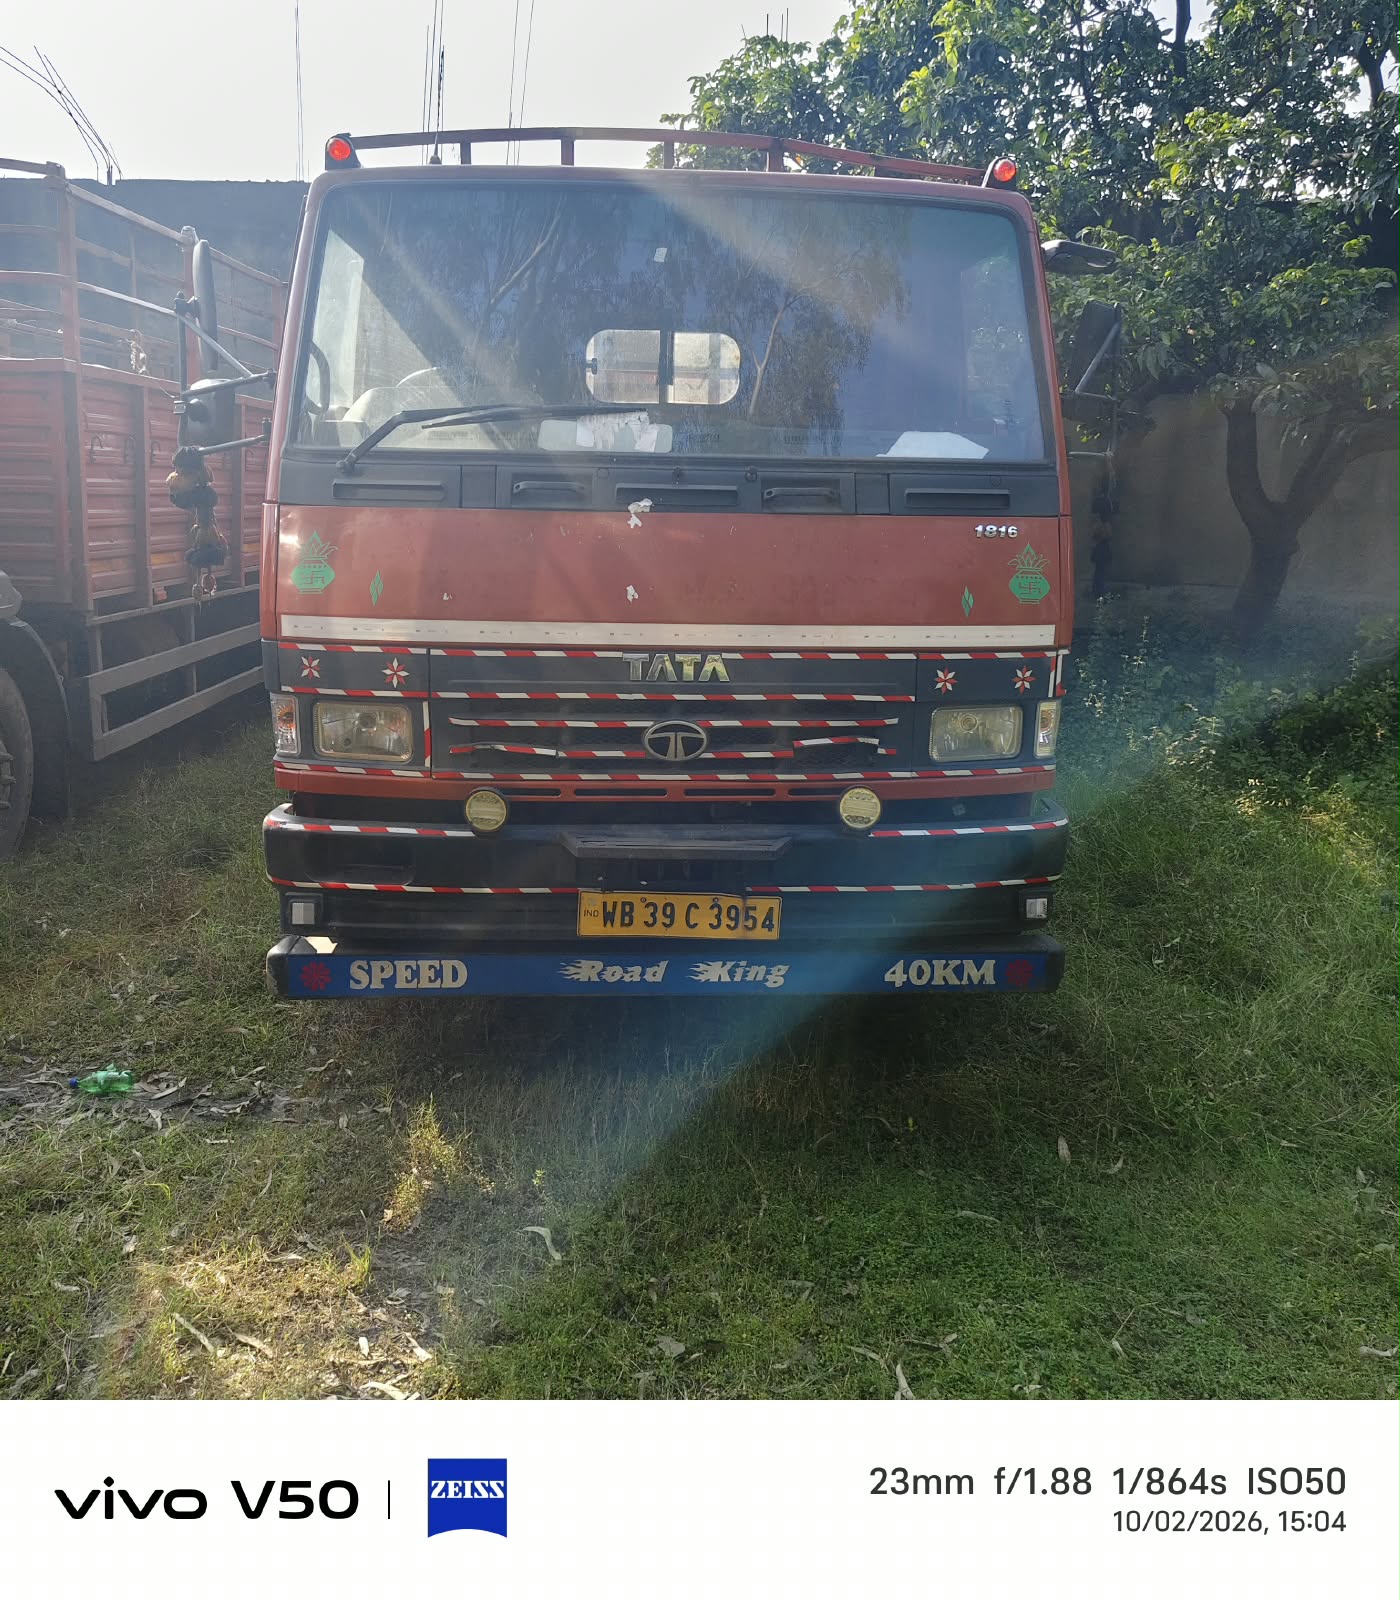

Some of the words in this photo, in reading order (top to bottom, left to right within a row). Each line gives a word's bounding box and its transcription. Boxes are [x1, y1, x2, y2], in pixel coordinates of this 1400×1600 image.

[974, 524, 1018, 538] 1816
[622, 653, 730, 682] TATA
[583, 909, 599, 918] IND
[602, 900, 635, 928] WB
[643, 901, 675, 929] 39
[685, 902, 699, 929] C
[708, 902, 775, 932] 3954
[350, 959, 468, 990] SPEED
[557, 959, 669, 983] Road
[685, 960, 790, 988] King
[884, 959, 996, 988] 40KM
